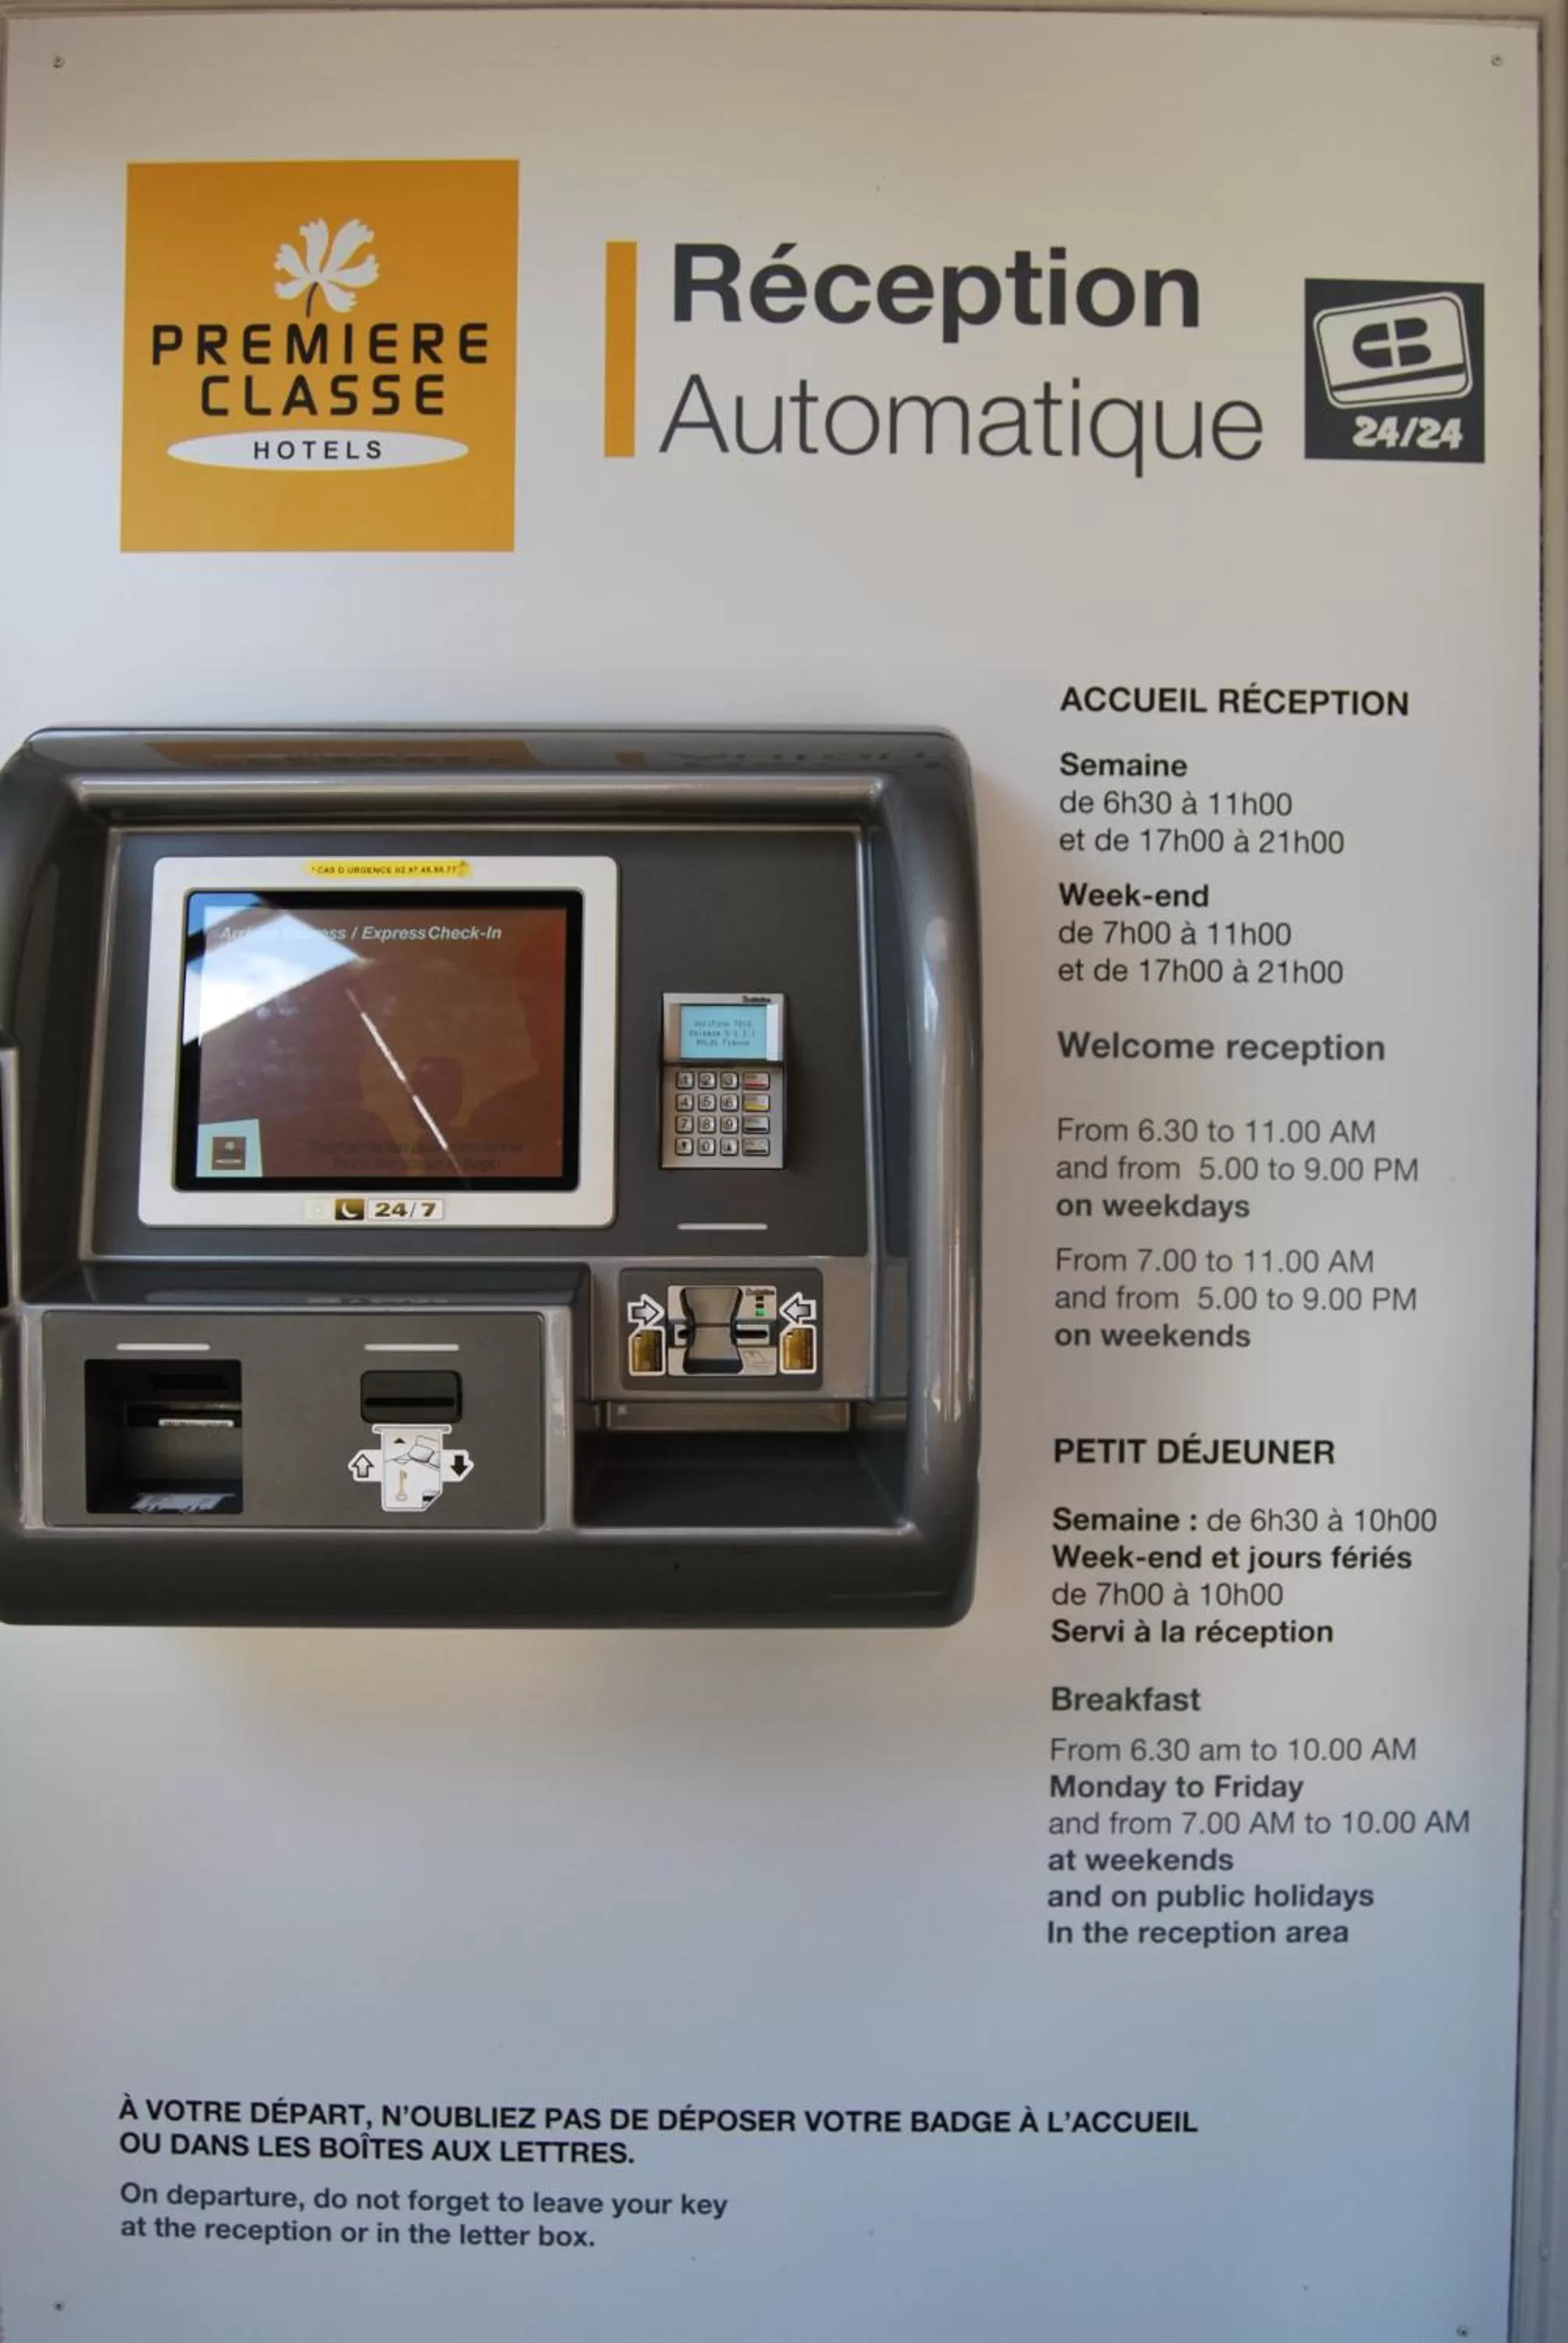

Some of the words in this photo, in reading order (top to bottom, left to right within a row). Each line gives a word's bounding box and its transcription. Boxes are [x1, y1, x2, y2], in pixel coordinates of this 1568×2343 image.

[675, 243, 1199, 343] Réception
[153, 323, 487, 365] PREMIERE
[201, 375, 444, 416] CLASSE
[659, 374, 1262, 478] Automatique
[1352, 415, 1463, 451] 24/24
[255, 440, 381, 459] HOTELS
[1060, 686, 1207, 712] ACCUEIL
[1219, 683, 1408, 715] RÉCEPTION
[1060, 752, 1187, 777] Semaine
[1060, 790, 1094, 814] de
[1104, 790, 1171, 815] 6h30
[1181, 791, 1197, 815] à
[1210, 792, 1292, 816] 11h00
[1060, 829, 1085, 851] et
[1095, 828, 1129, 852] de
[1141, 829, 1224, 852] 17h00
[1234, 829, 1249, 853] à
[1260, 829, 1344, 854] 21h00
[347, 865, 391, 875] URGENCE
[1059, 883, 1208, 908] Week-end
[362, 925, 426, 943] Express
[427, 925, 503, 940] Check-In
[1059, 920, 1093, 944] de
[1104, 921, 1171, 945] 7h00
[1181, 922, 1196, 945] à
[1209, 922, 1291, 947] 11h00
[1059, 959, 1084, 981] et
[1094, 958, 1128, 982] de
[1140, 959, 1223, 982] 17h00
[1233, 959, 1249, 983] à
[1258, 960, 1343, 984] 21h00
[1057, 1031, 1214, 1059] Welcome
[1227, 1034, 1384, 1066] reception
[1058, 1118, 1128, 1142] From
[1139, 1118, 1198, 1142] 6.30
[1207, 1120, 1234, 1143] to
[1246, 1120, 1320, 1143] 11.00
[1330, 1120, 1374, 1143] AM
[1057, 1156, 1107, 1179] and
[1118, 1156, 1180, 1179] from
[1199, 1157, 1258, 1181] 5.00
[1268, 1157, 1295, 1181] to
[1305, 1157, 1363, 1181] 9.00
[1374, 1157, 1418, 1181] PM
[374, 1202, 437, 1218] 24/7
[1057, 1199, 1092, 1216] on
[1103, 1193, 1249, 1223] weekdays
[1057, 1247, 1126, 1271] From
[1139, 1249, 1196, 1272] 7.00
[1206, 1250, 1233, 1272] to
[1245, 1250, 1319, 1273] 11.00
[1328, 1250, 1374, 1273] AM
[1056, 1286, 1106, 1309] and
[1117, 1286, 1178, 1309] from
[1199, 1286, 1257, 1310] 5.00
[1267, 1288, 1293, 1311] to
[1303, 1287, 1362, 1311] 9.00
[1373, 1287, 1417, 1311] PM
[1055, 1328, 1090, 1346] on
[1101, 1324, 1250, 1347] weekends
[1055, 1439, 1146, 1464] PETIT
[1159, 1432, 1334, 1464] DÉJEUNER
[1053, 1507, 1180, 1532] Semaine
[1207, 1509, 1241, 1532] de
[1251, 1508, 1317, 1532] 6h30
[1327, 1508, 1342, 1532] à
[1356, 1508, 1437, 1532] 10h00
[1053, 1545, 1201, 1568] Week-end
[1212, 1547, 1239, 1568] et
[1248, 1546, 1321, 1574] jours
[1331, 1546, 1412, 1569] fériés
[1052, 1582, 1086, 1606] de
[1097, 1582, 1164, 1606] 7h00
[1174, 1582, 1189, 1606] à
[1201, 1582, 1283, 1606] 10h00
[1052, 1619, 1124, 1642] Servi
[1135, 1620, 1149, 1642] à
[1162, 1620, 1185, 1642] la
[1196, 1620, 1333, 1648] réception
[1053, 1687, 1201, 1712] Breakfast
[1051, 1738, 1120, 1761] From
[1131, 1739, 1189, 1761] 6.30
[1199, 1744, 1240, 1761] am
[1251, 1739, 1277, 1761] to
[1289, 1738, 1362, 1761] 10.00
[1371, 1737, 1416, 1760] AM
[1051, 1774, 1167, 1803] Monday
[1176, 1776, 1204, 1798] to
[1215, 1774, 1304, 1803] Friday
[1049, 1812, 1099, 1835] and
[1109, 1811, 1171, 1835] from
[1182, 1812, 1240, 1835] 7.00
[1249, 1811, 1294, 1834] AM
[1305, 1813, 1331, 1834] to
[1343, 1810, 1415, 1834] 10.00
[1424, 1810, 1469, 1833] AM
[1049, 1849, 1075, 1870] at
[1085, 1848, 1234, 1871] weekends
[1048, 1885, 1101, 1907] and
[1112, 1890, 1146, 1907] on
[1157, 1885, 1244, 1912] public
[1255, 1884, 1374, 1912] holidays
[1048, 1921, 1072, 1943] In
[1083, 1920, 1128, 1943] the
[1139, 1921, 1275, 1949] reception
[1286, 1926, 1348, 1943] area
[119, 2093, 138, 2120] À
[146, 2099, 241, 2122] VOTRE
[251, 2097, 372, 2129] DÉPART,
[383, 2105, 536, 2128] N'OUBLIEZ
[546, 2108, 600, 2130] PAS
[611, 2109, 648, 2130] DE
[659, 2104, 795, 2131] DÉPOSER
[804, 2110, 901, 2132] VOTRE
[911, 2111, 1010, 2133] BADGE
[1019, 2106, 1039, 2132] À
[1048, 2111, 1198, 2133] L'ACCUEIL
[120, 2132, 160, 2154] OU
[172, 2134, 249, 2156] DANS
[259, 2136, 310, 2158] LES
[320, 2134, 423, 2160] BOÎTES
[432, 2140, 490, 2161] AUX
[501, 2141, 634, 2163] LETTRES.
[121, 2182, 157, 2204] On
[167, 2184, 305, 2212] departure,
[314, 2188, 347, 2209] do
[357, 2191, 400, 2209] not
[408, 2190, 489, 2216] forget
[497, 2192, 524, 2212] to
[534, 2191, 604, 2213] leave
[612, 2199, 672, 2218] your
[682, 2194, 728, 2220] key
[121, 2217, 146, 2237] at
[155, 2216, 196, 2238] the
[205, 2220, 331, 2245] reception
[341, 2227, 369, 2242] or
[377, 2223, 399, 2243] in
[408, 2224, 451, 2245] the
[461, 2224, 530, 2245] letter
[539, 2225, 594, 2246] box.
